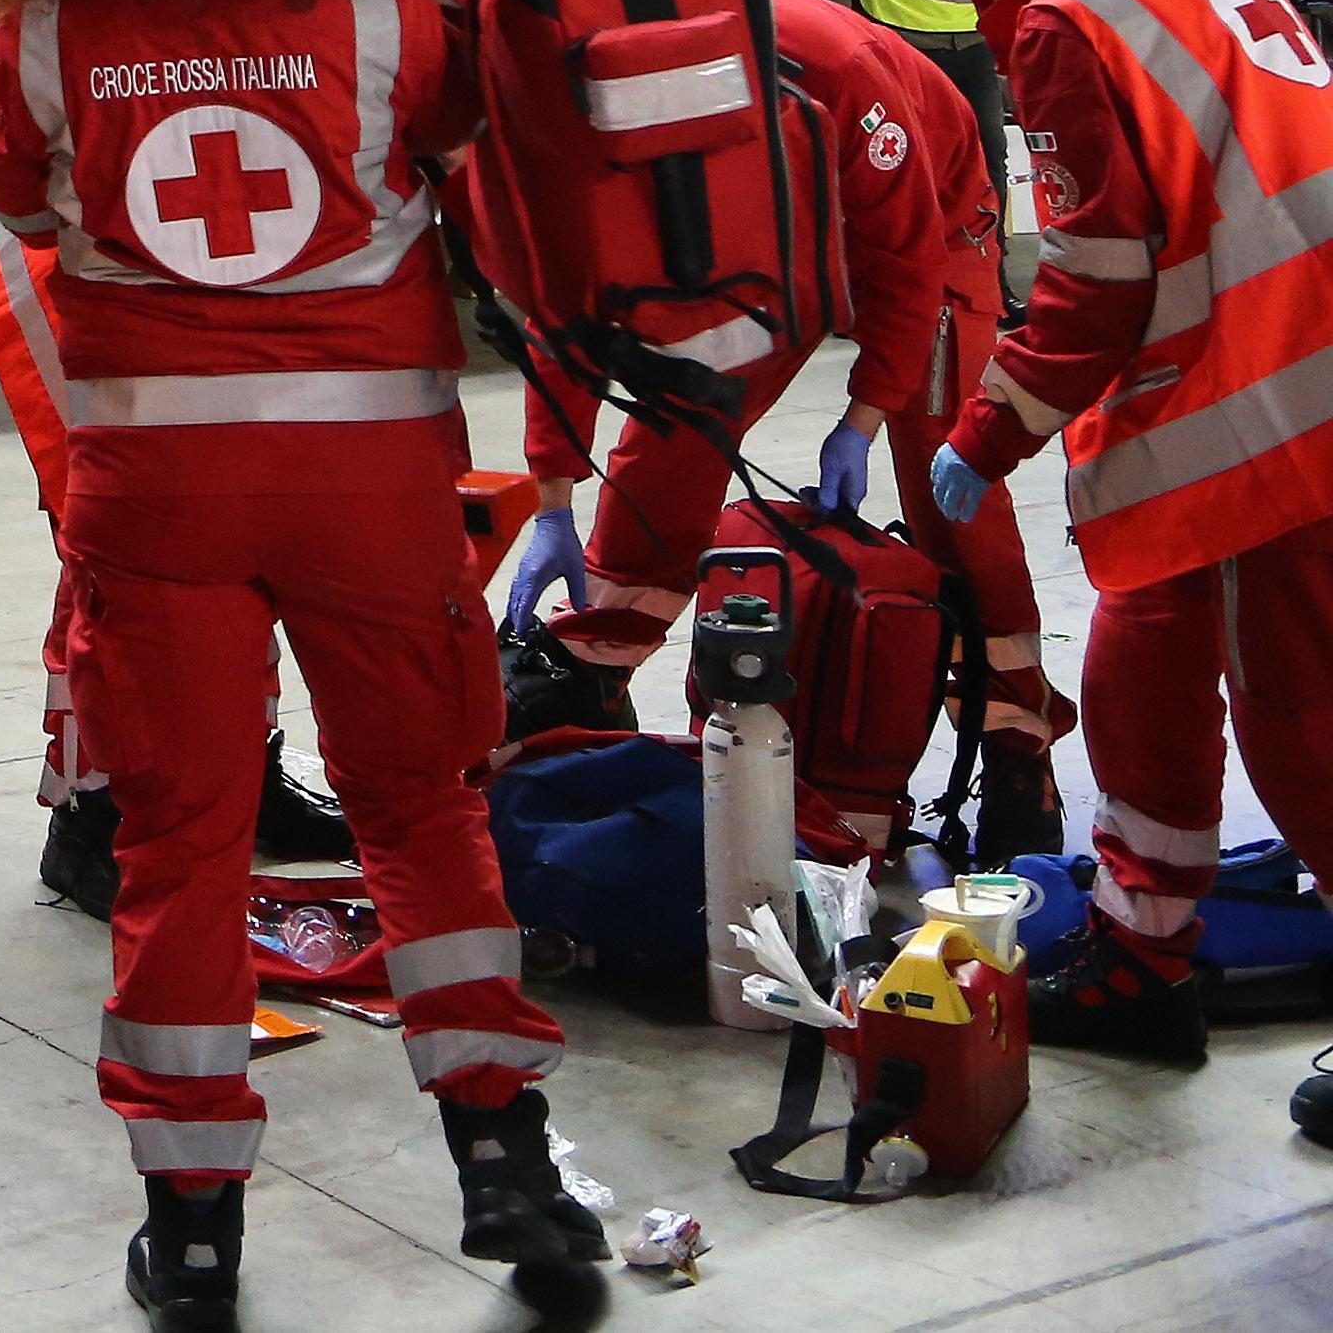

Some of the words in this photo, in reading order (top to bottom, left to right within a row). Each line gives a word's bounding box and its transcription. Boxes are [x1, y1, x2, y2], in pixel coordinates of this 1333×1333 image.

[90, 62, 161, 100] CROCE
[162, 57, 228, 94] ROSSA
[231, 53, 318, 90] ITALIANA
